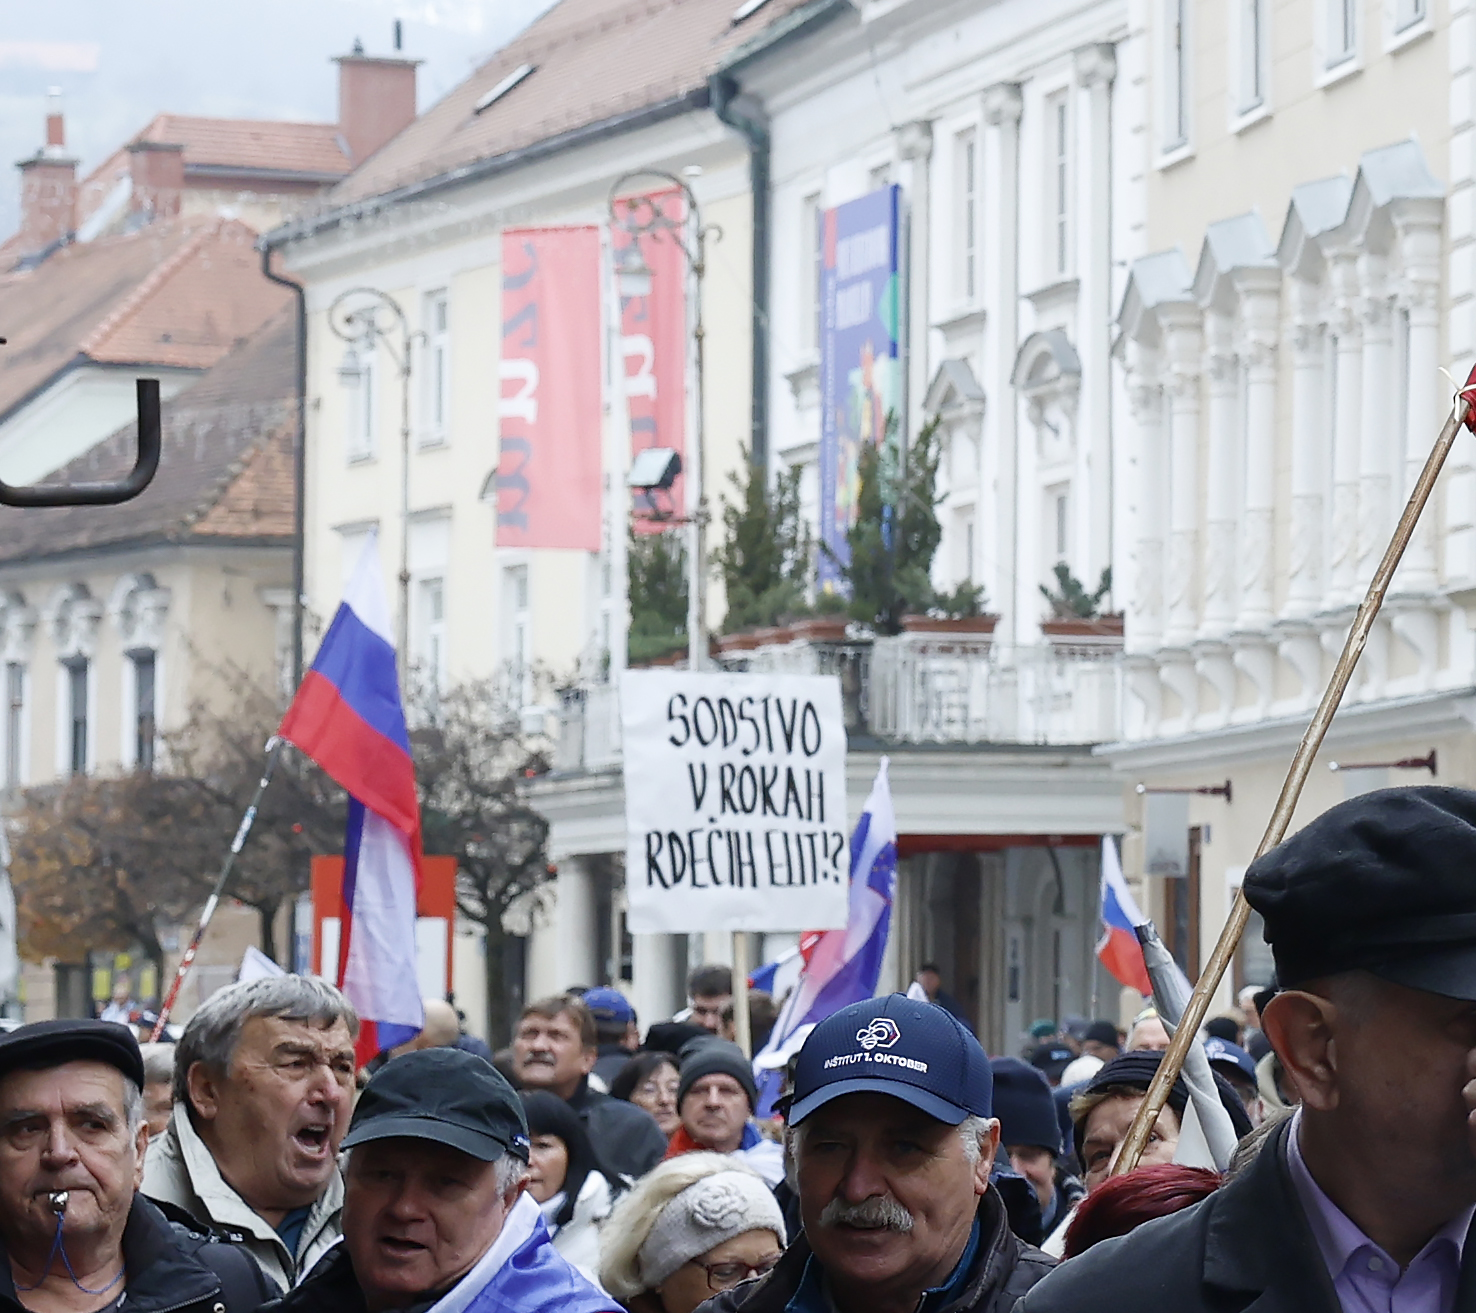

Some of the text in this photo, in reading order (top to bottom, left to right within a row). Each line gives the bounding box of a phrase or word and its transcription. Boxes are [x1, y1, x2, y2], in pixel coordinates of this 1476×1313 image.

[667, 693, 822, 757] SODSTVO
[687, 762, 825, 823] V ROKAH
[646, 817, 759, 890] RDEČIH
[873, 1052, 928, 1074] OKTOBER
